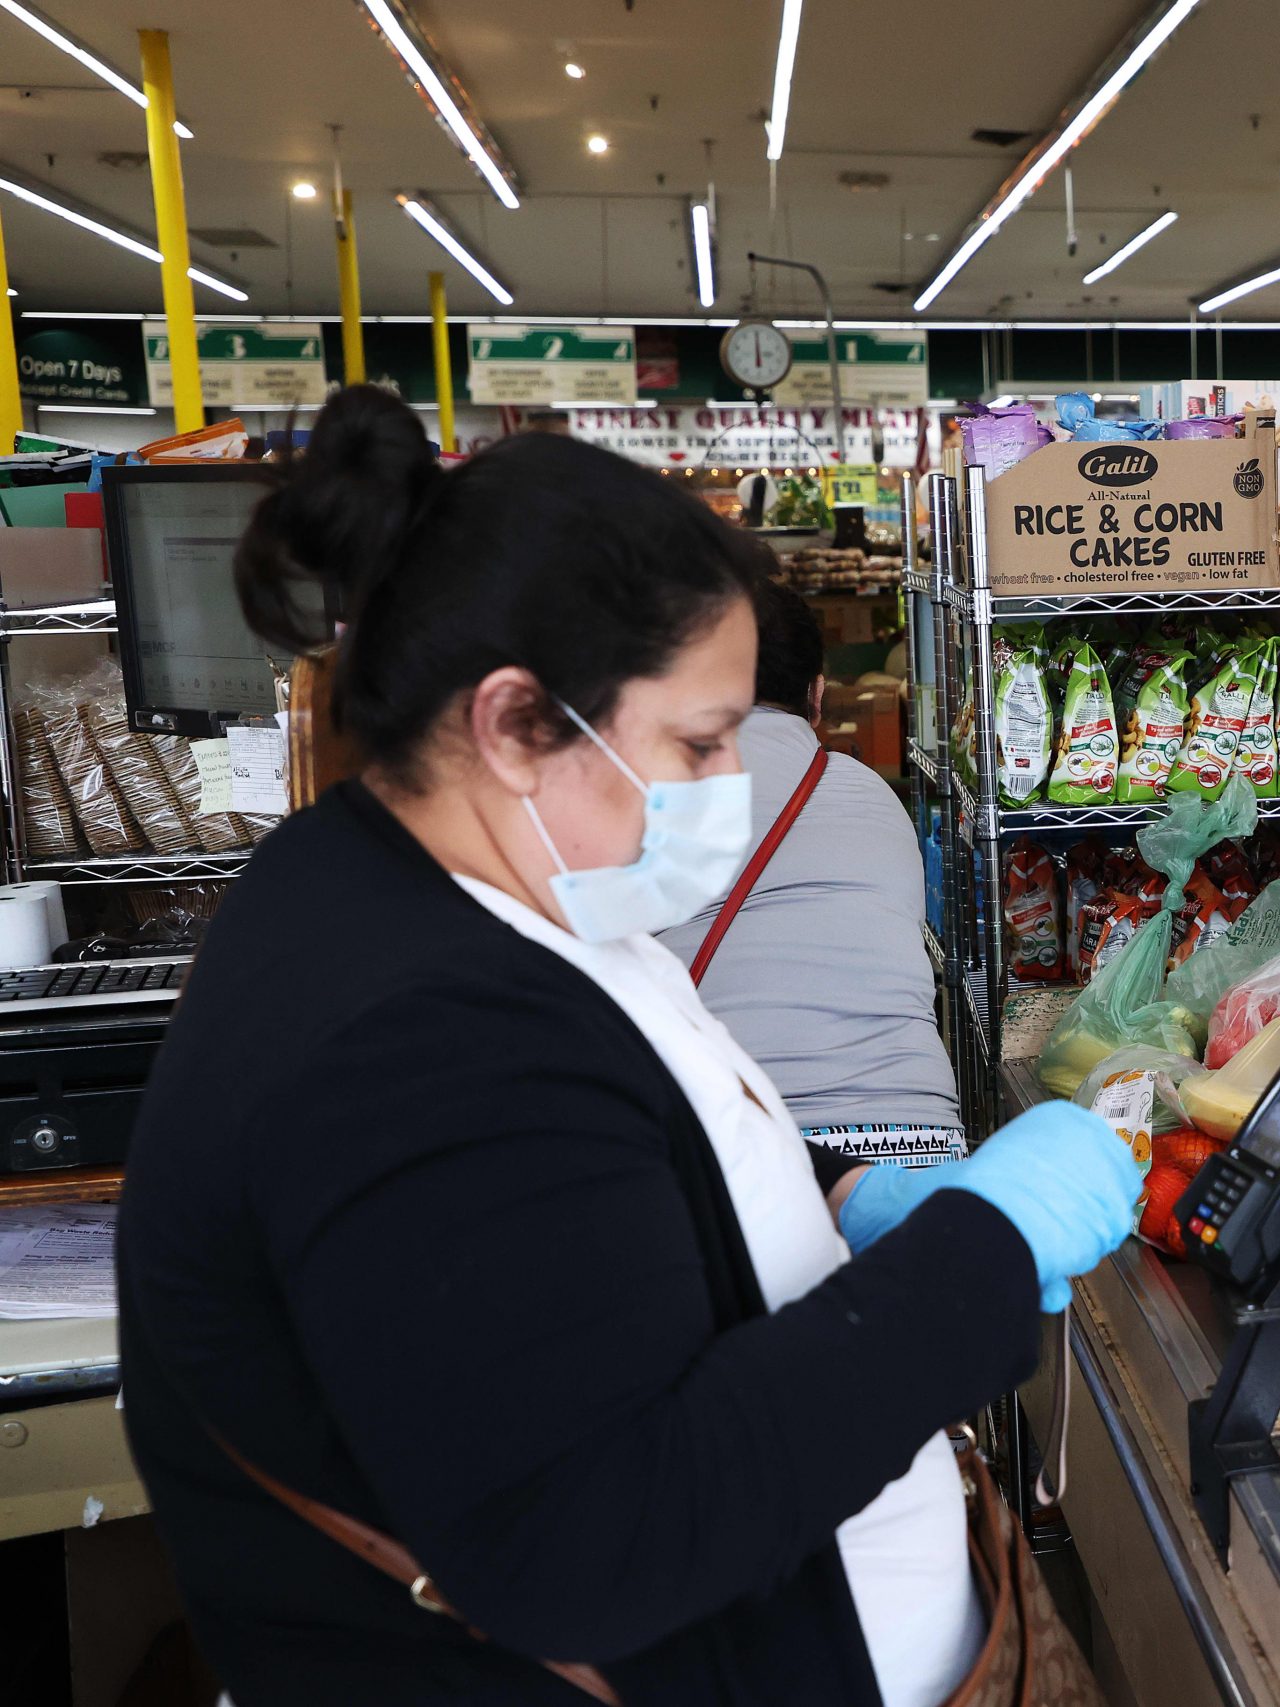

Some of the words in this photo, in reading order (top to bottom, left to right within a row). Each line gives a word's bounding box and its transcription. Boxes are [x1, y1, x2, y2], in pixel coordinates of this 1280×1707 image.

[225, 335, 246, 358] 3
[543, 335, 564, 360] 2
[20, 355, 65, 377] Open
[68, 360, 78, 378] 7
[82, 360, 122, 384] Days
[575, 408, 680, 429] FINEST
[694, 407, 827, 429] QUALITY
[1084, 451, 1149, 477] Galil
[1238, 474, 1260, 483] NON
[1238, 483, 1260, 492] GMO
[1088, 490, 1150, 501] All-Natural
[1014, 504, 1085, 535] RICE
[1099, 503, 1120, 534] &
[1134, 501, 1224, 533] CORN
[1069, 536, 1171, 567] CAKES
[1188, 552, 1235, 566] GLUTEN
[1238, 550, 1266, 565] FREE
[1064, 570, 1128, 583] cholesterol
[1131, 570, 1154, 582] free
[1164, 570, 1200, 582] vegan
[1209, 569, 1231, 579] low
[1233, 568, 1249, 580] fat
